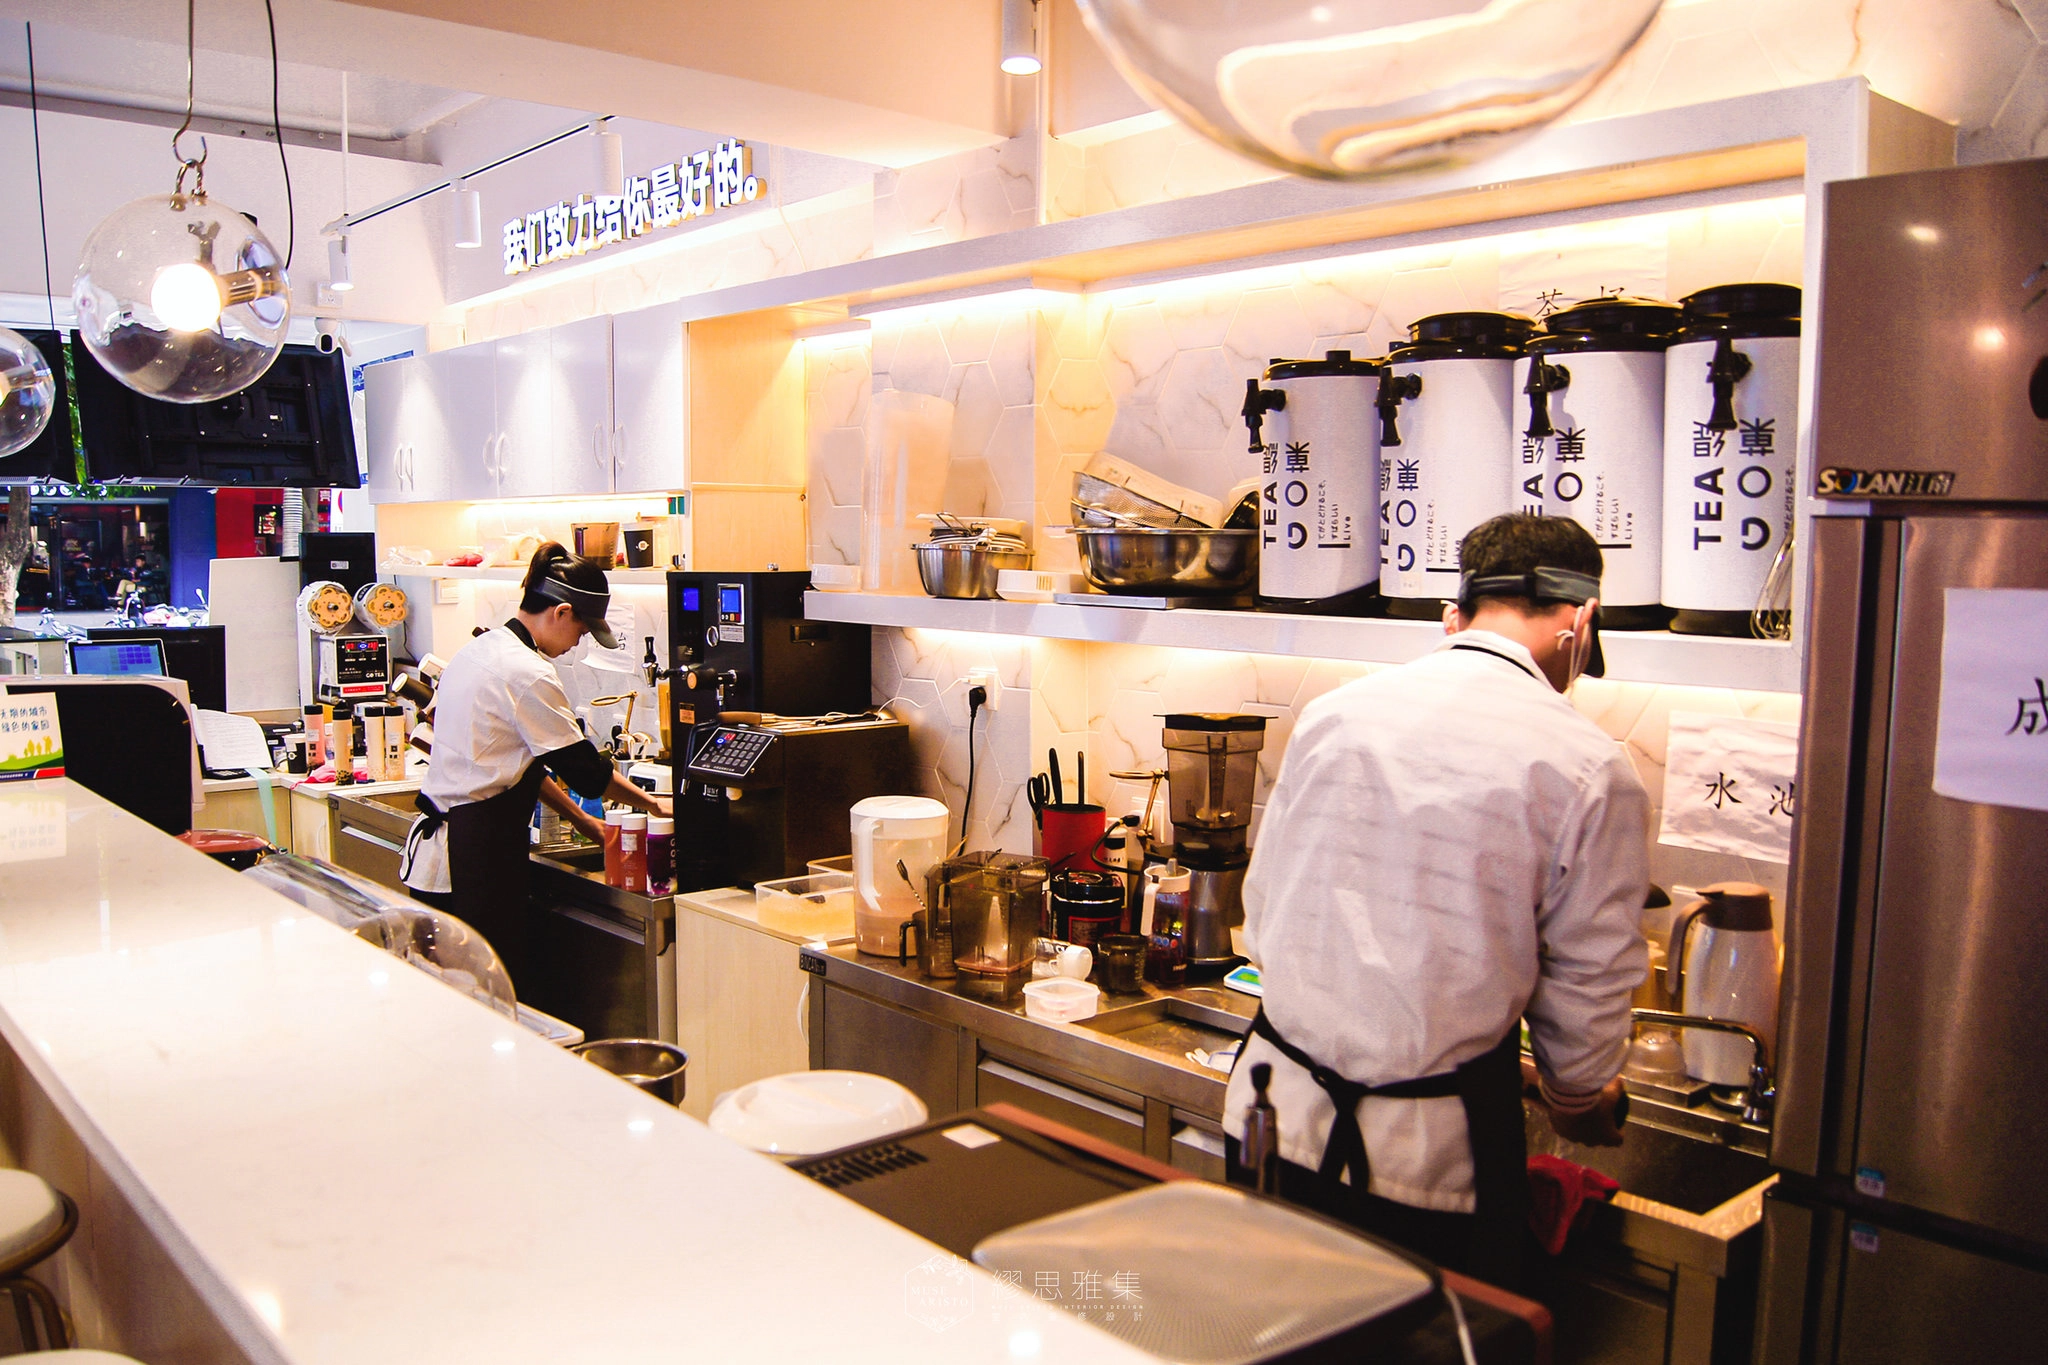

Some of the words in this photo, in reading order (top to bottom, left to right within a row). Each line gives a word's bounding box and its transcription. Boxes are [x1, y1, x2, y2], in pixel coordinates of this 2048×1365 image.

[503, 137, 764, 275] 我们致力给你最好的。
[1817, 468, 1906, 494] SOLAN
[1263, 481, 1278, 550] TEA
[1343, 516, 1352, 541] Live
[1624, 512, 1633, 540] Live
[1692, 467, 1725, 551] TEA
